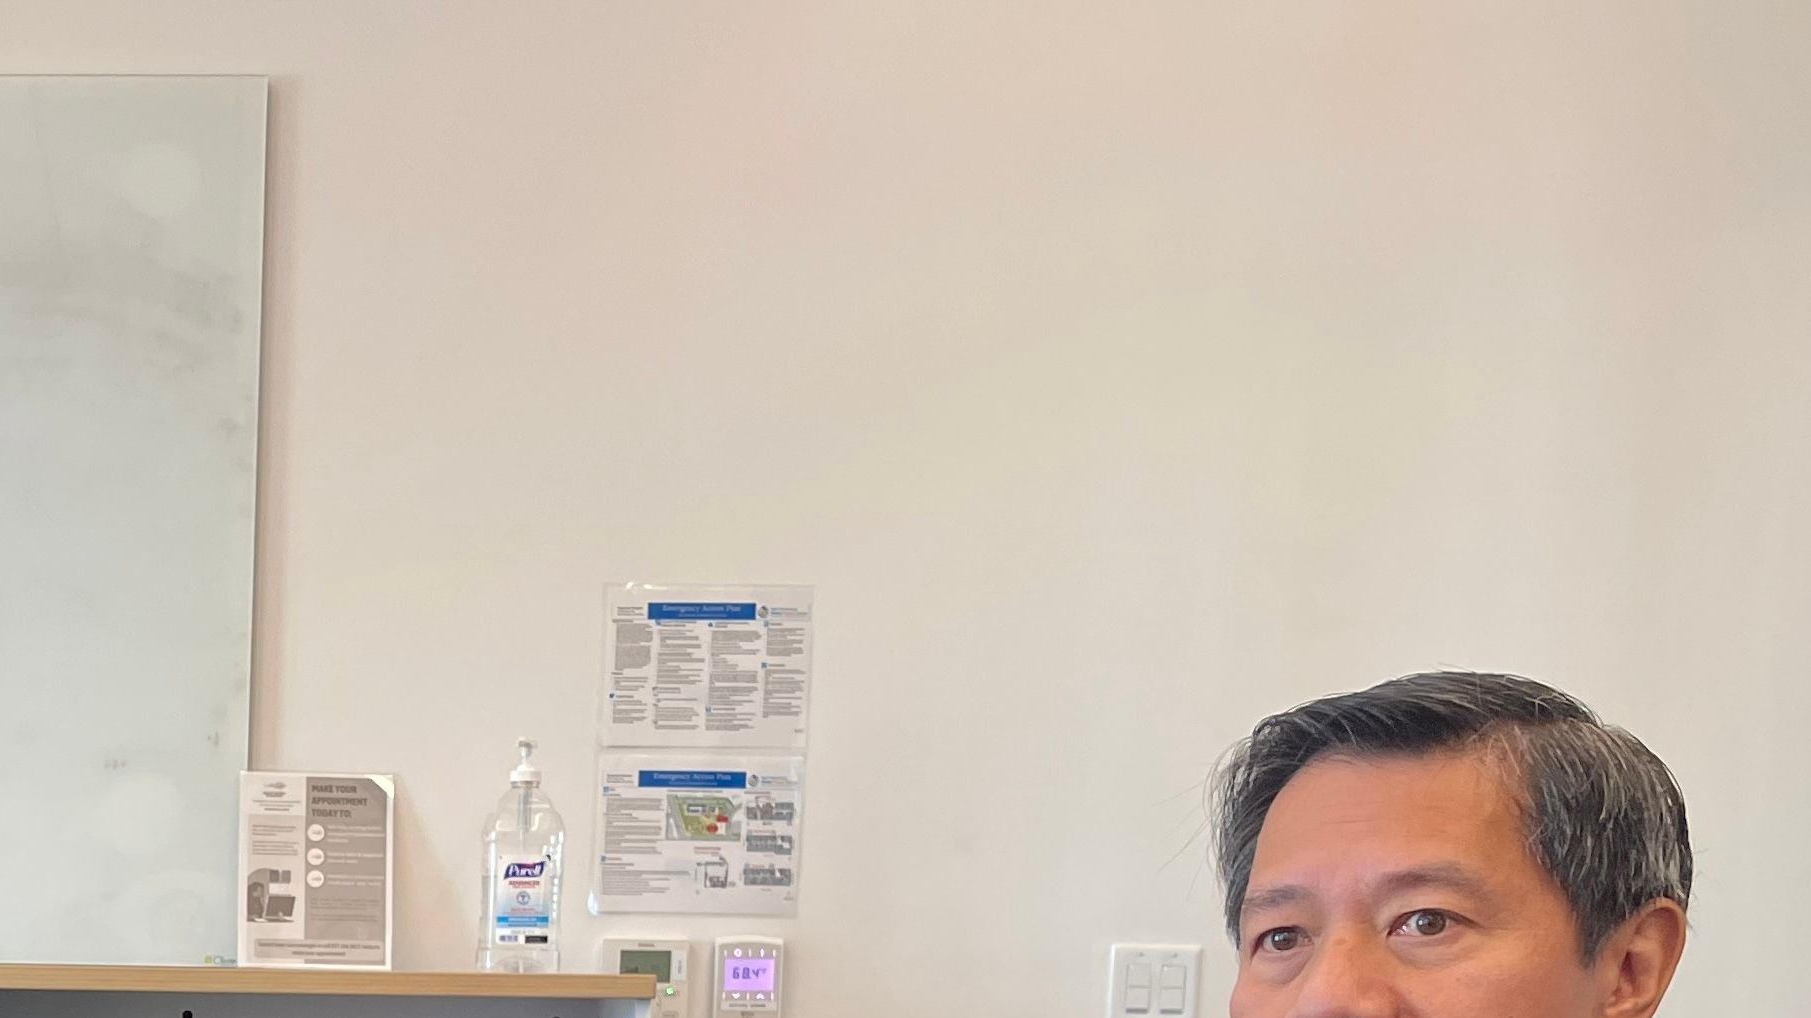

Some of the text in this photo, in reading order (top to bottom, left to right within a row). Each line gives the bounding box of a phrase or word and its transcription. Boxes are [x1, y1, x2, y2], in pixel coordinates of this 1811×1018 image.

[311, 784, 357, 794] MAKE YOUR
[311, 797, 367, 807] APPOINTMENT
[311, 808, 337, 818] TODAY
